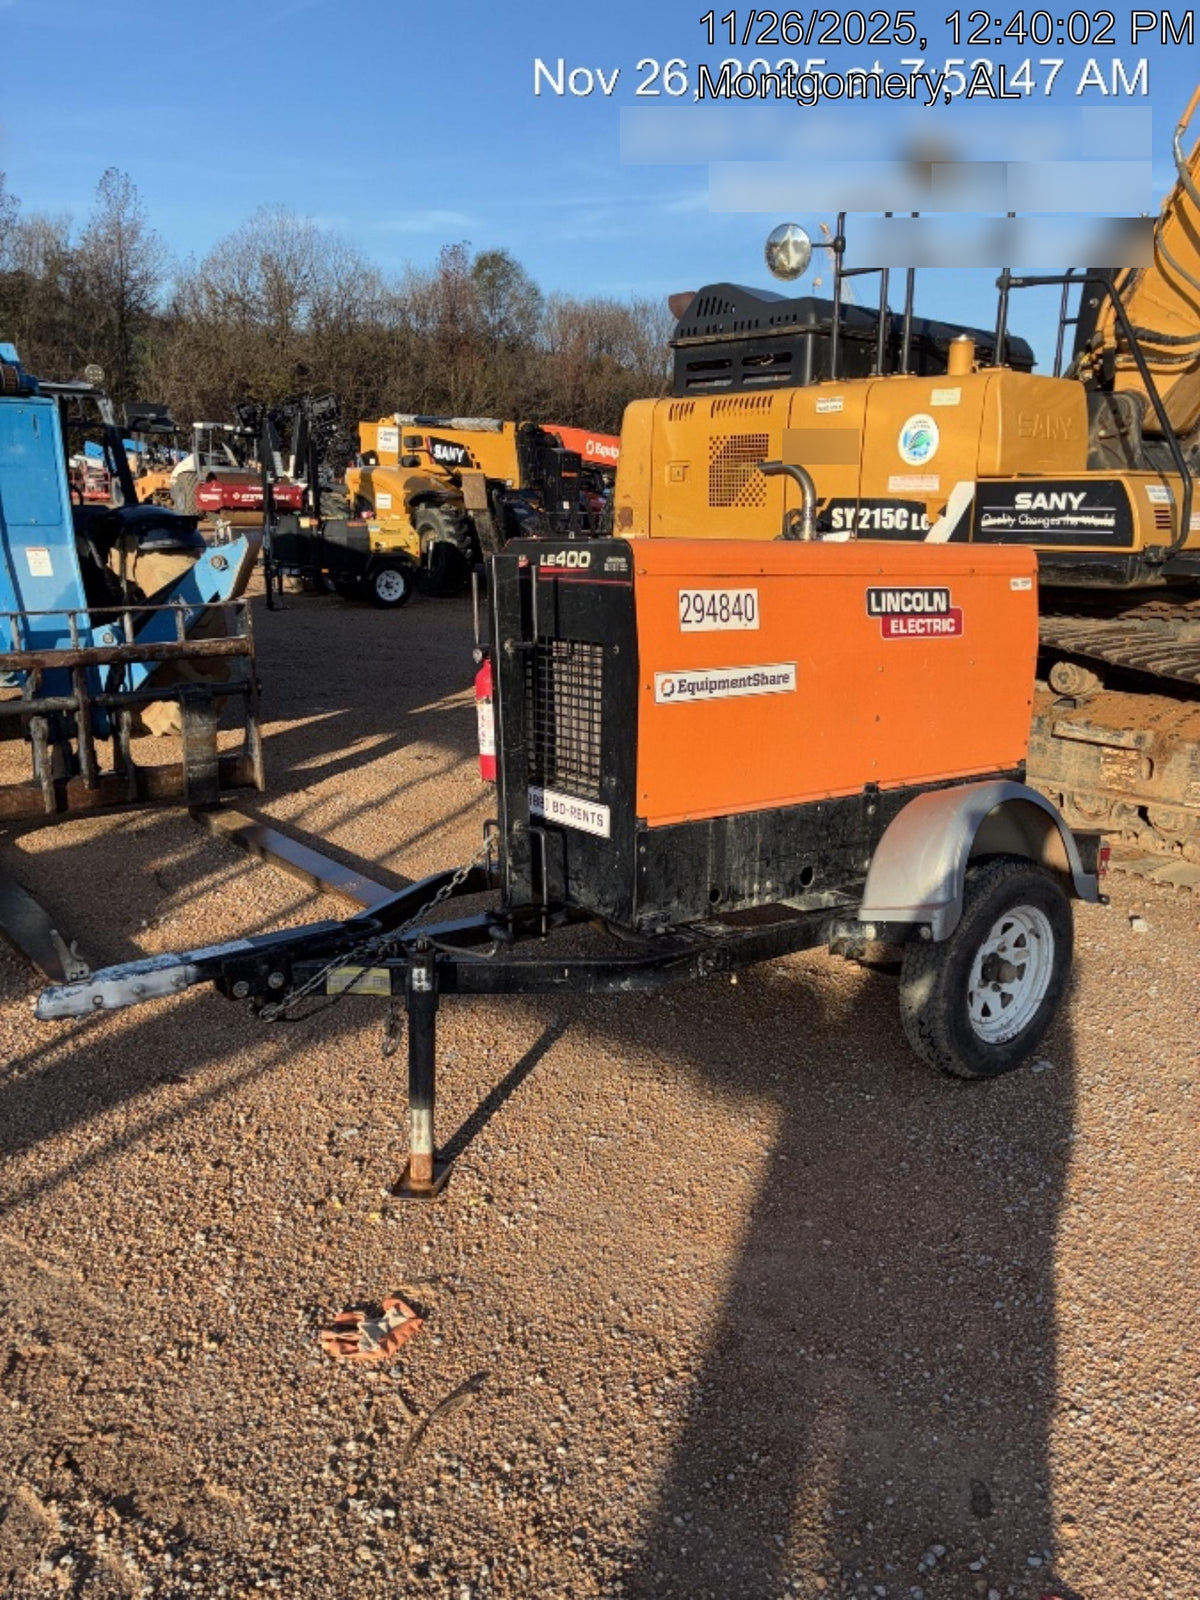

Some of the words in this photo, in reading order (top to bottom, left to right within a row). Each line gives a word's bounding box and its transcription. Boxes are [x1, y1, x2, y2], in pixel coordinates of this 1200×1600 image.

[433, 444, 465, 463] SANY
[1014, 492, 1087, 511] SANY
[1018, 513, 1062, 528] Changes
[540, 550, 591, 568] LE400
[680, 593, 755, 624] 294840
[870, 591, 947, 613] LINCOLN
[890, 618, 956, 634] ELECTRIC
[677, 673, 790, 696] EquipmentShare
